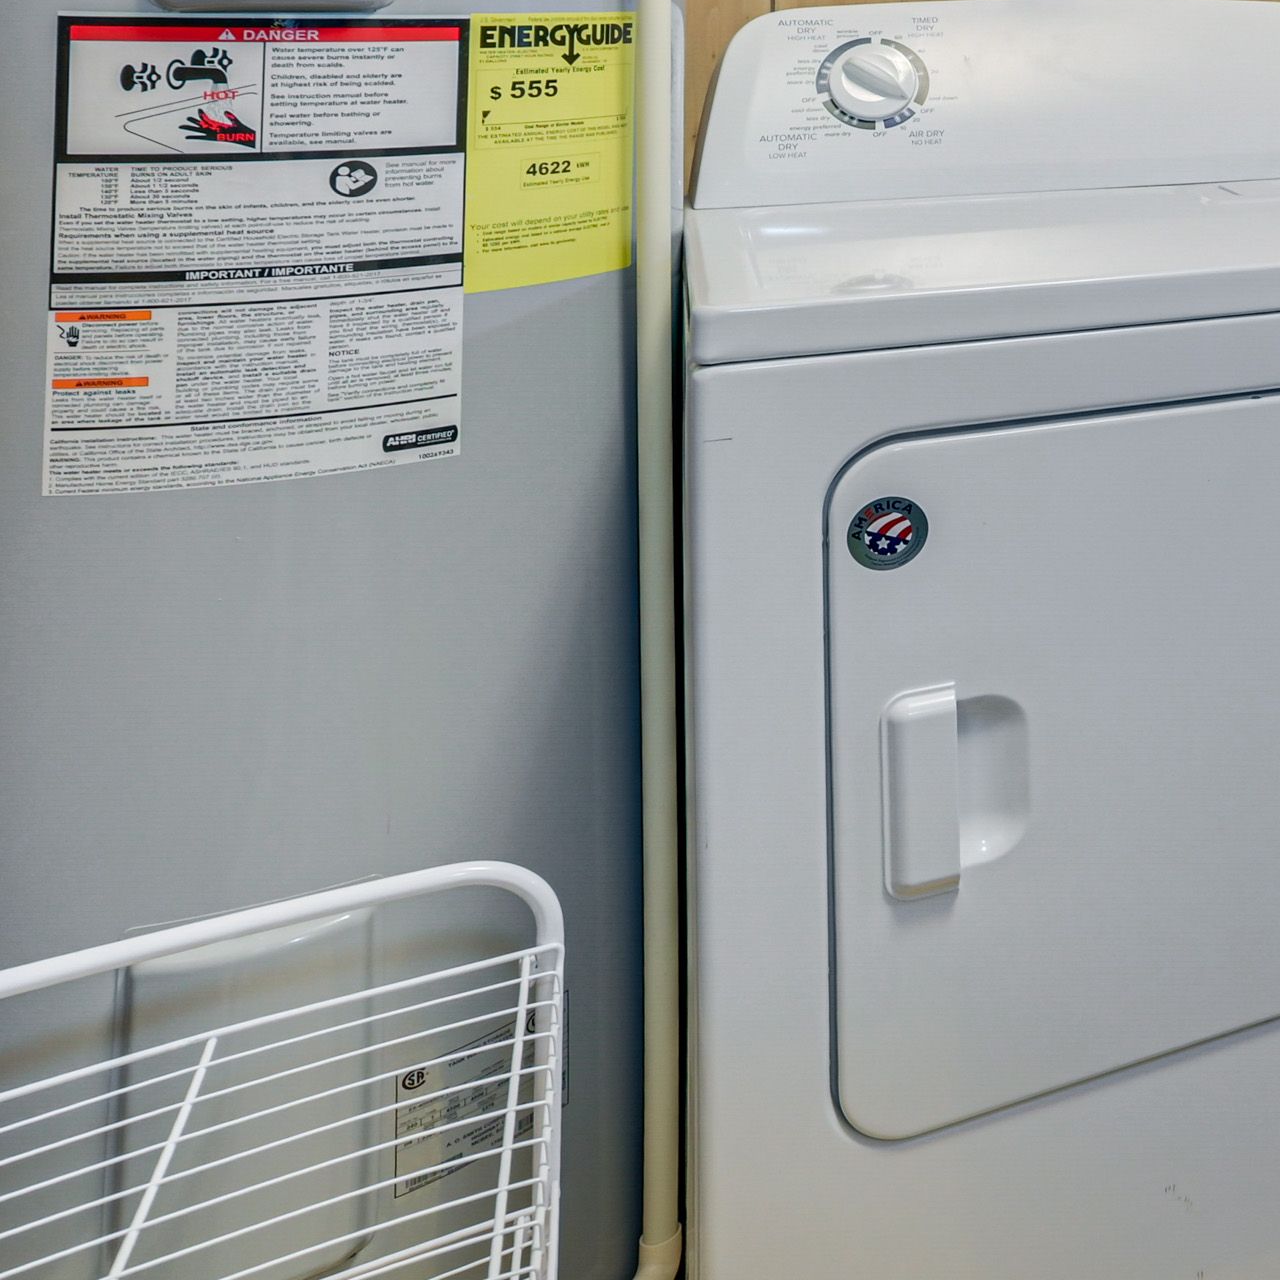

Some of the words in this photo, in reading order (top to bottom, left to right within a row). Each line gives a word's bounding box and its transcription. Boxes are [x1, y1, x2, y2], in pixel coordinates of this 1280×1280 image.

[778, 19, 834, 27] AUTOMATIC
[912, 16, 938, 24] TIMED
[796, 26, 816, 34] DRY
[916, 24, 935, 32] DRY
[243, 29, 320, 41] DANGER
[489, 86, 502, 101] $
[510, 79, 559, 99] 555
[204, 91, 238, 100] HOT
[216, 133, 255, 141] BURN
[759, 133, 817, 142] AUTOMATIC
[908, 130, 925, 138] AIR
[927, 129, 945, 138] DRY
[924, 138, 942, 146] HEAT
[778, 143, 799, 152] DRY
[526, 159, 572, 177] 4622
[185, 269, 261, 281] IMPORTANT
[271, 262, 354, 276] IMPORTANTE
[86, 313, 127, 321] WARNING
[328, 349, 360, 357] NOTICE
[83, 380, 124, 388] WARNING
[416, 429, 452, 443] CERTIFIED
[851, 500, 913, 541] AMERICA
